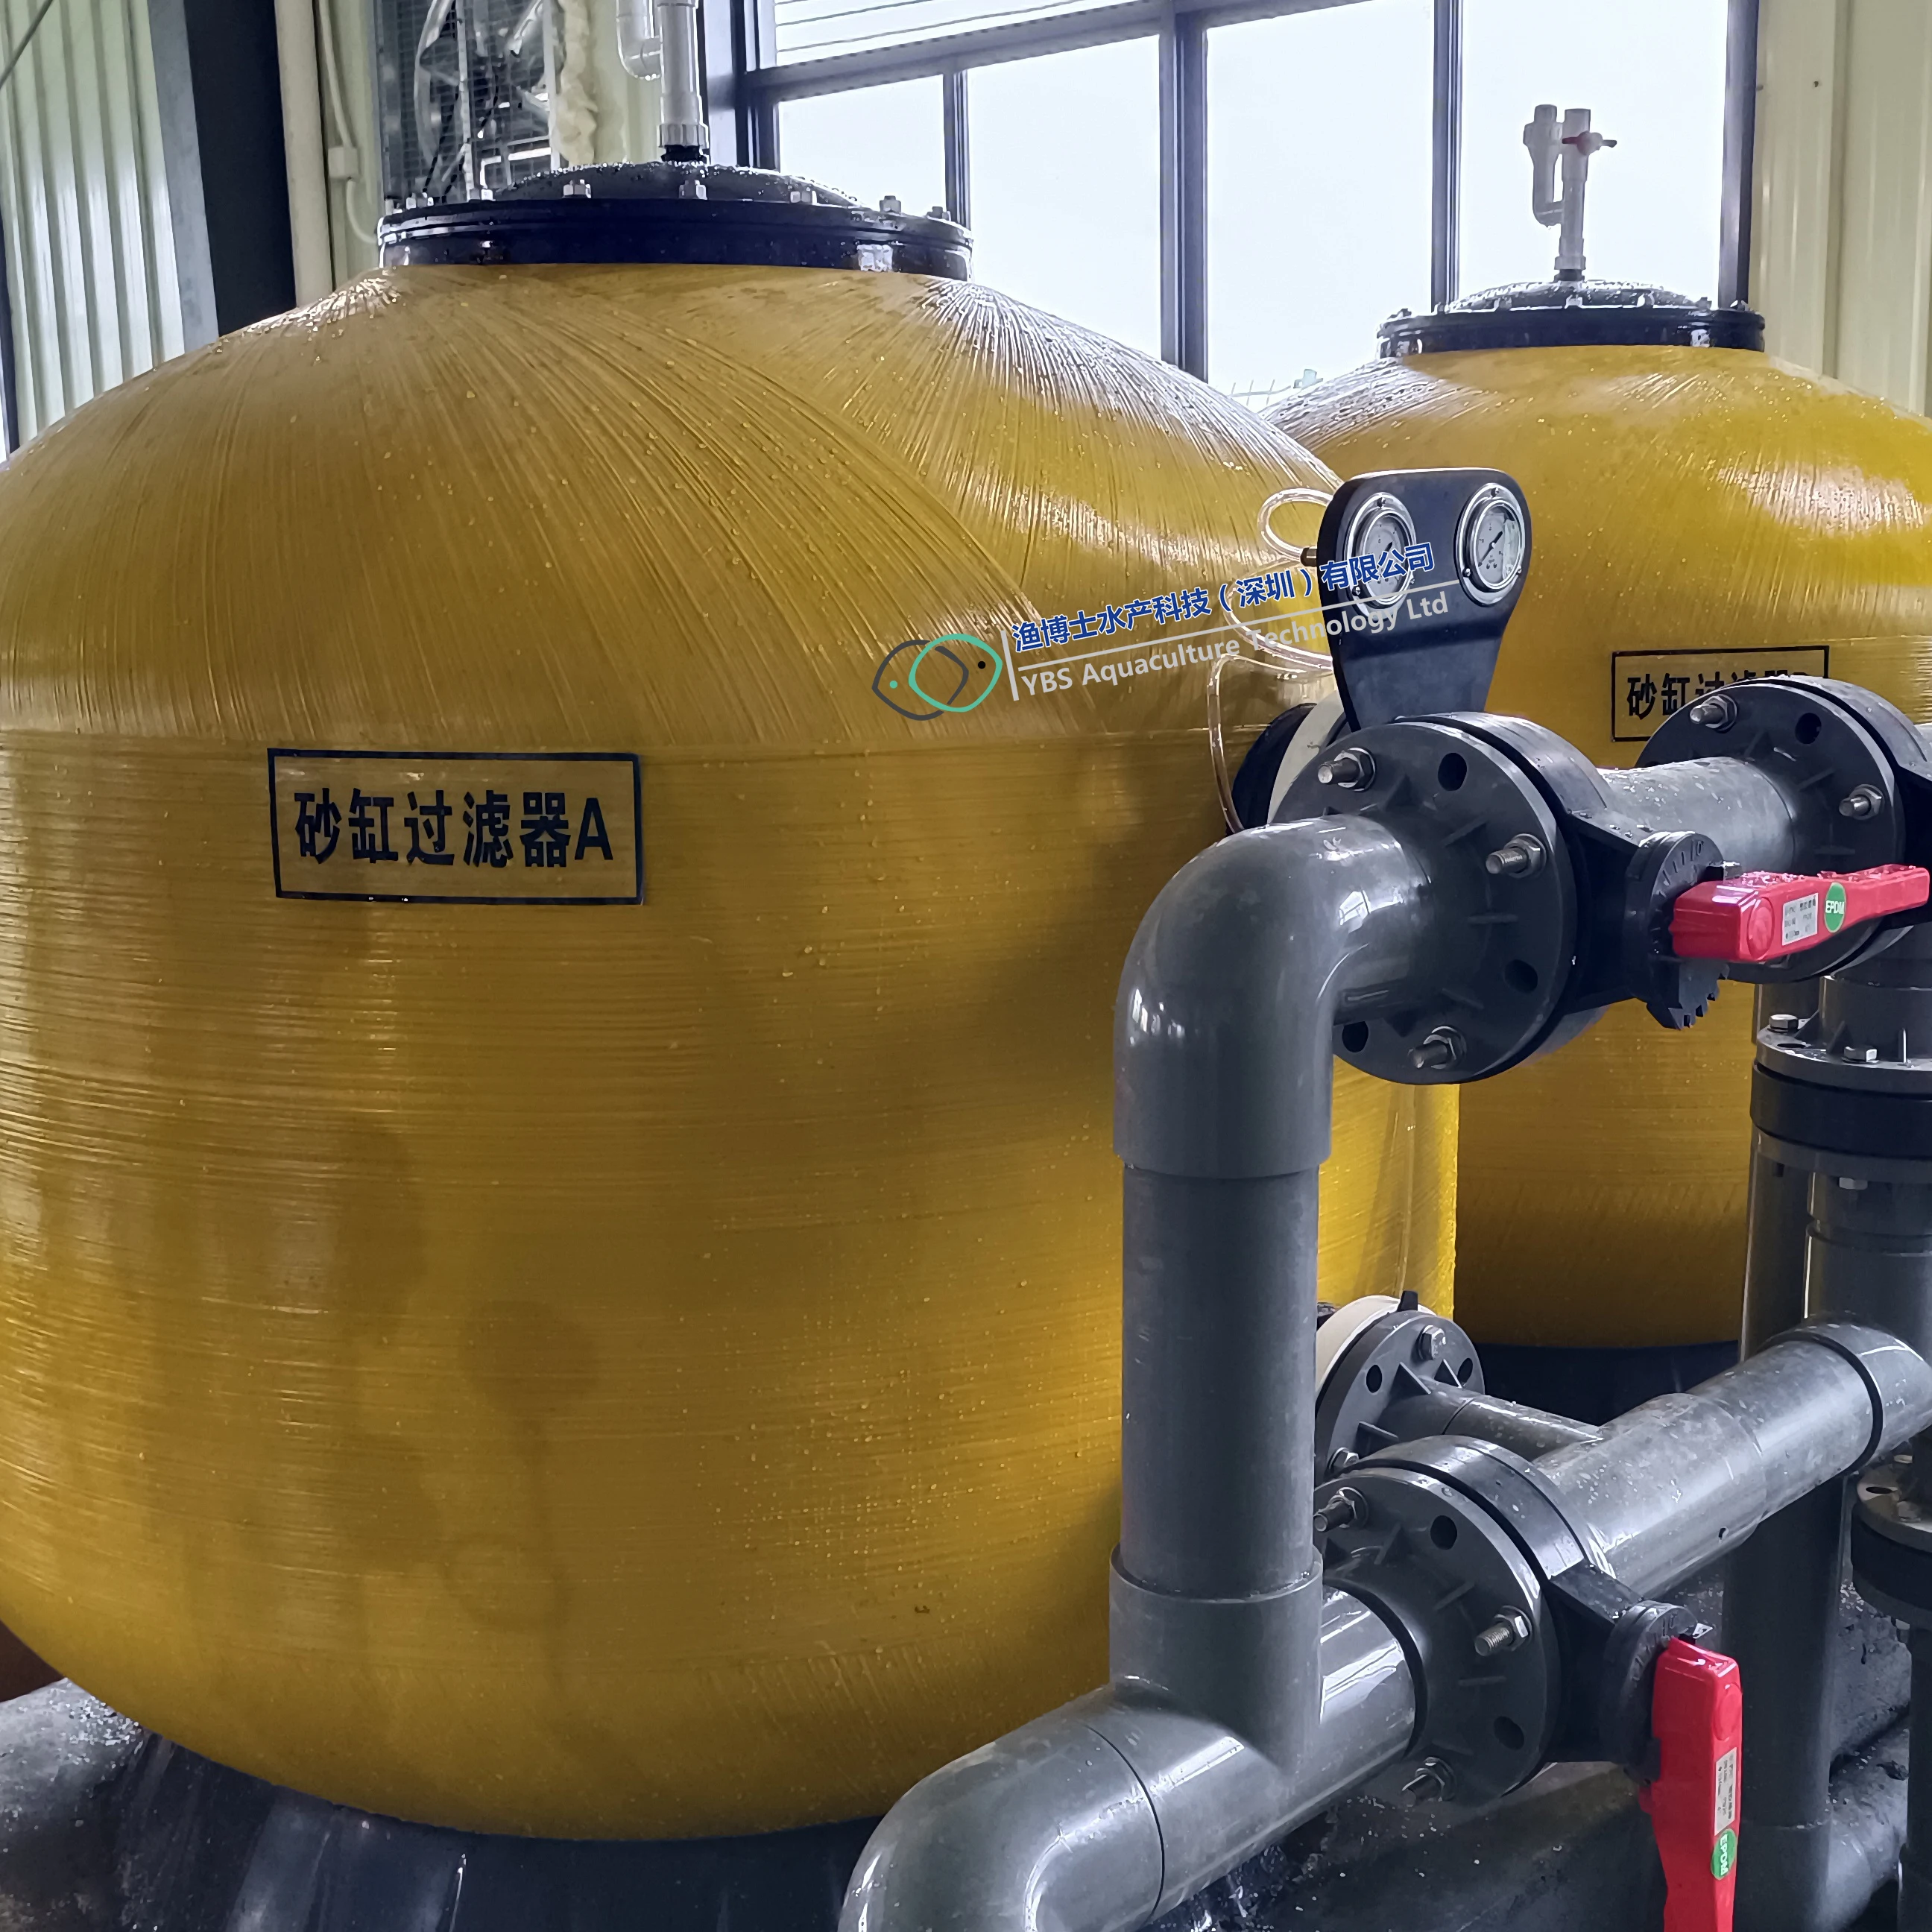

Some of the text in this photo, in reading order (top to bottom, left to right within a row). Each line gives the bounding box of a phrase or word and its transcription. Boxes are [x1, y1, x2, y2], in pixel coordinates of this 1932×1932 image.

[294, 787, 613, 868] 砂缸过滤器A
[1825, 900, 1845, 915] EPDM
[1720, 1834, 1729, 1876] EPDM
